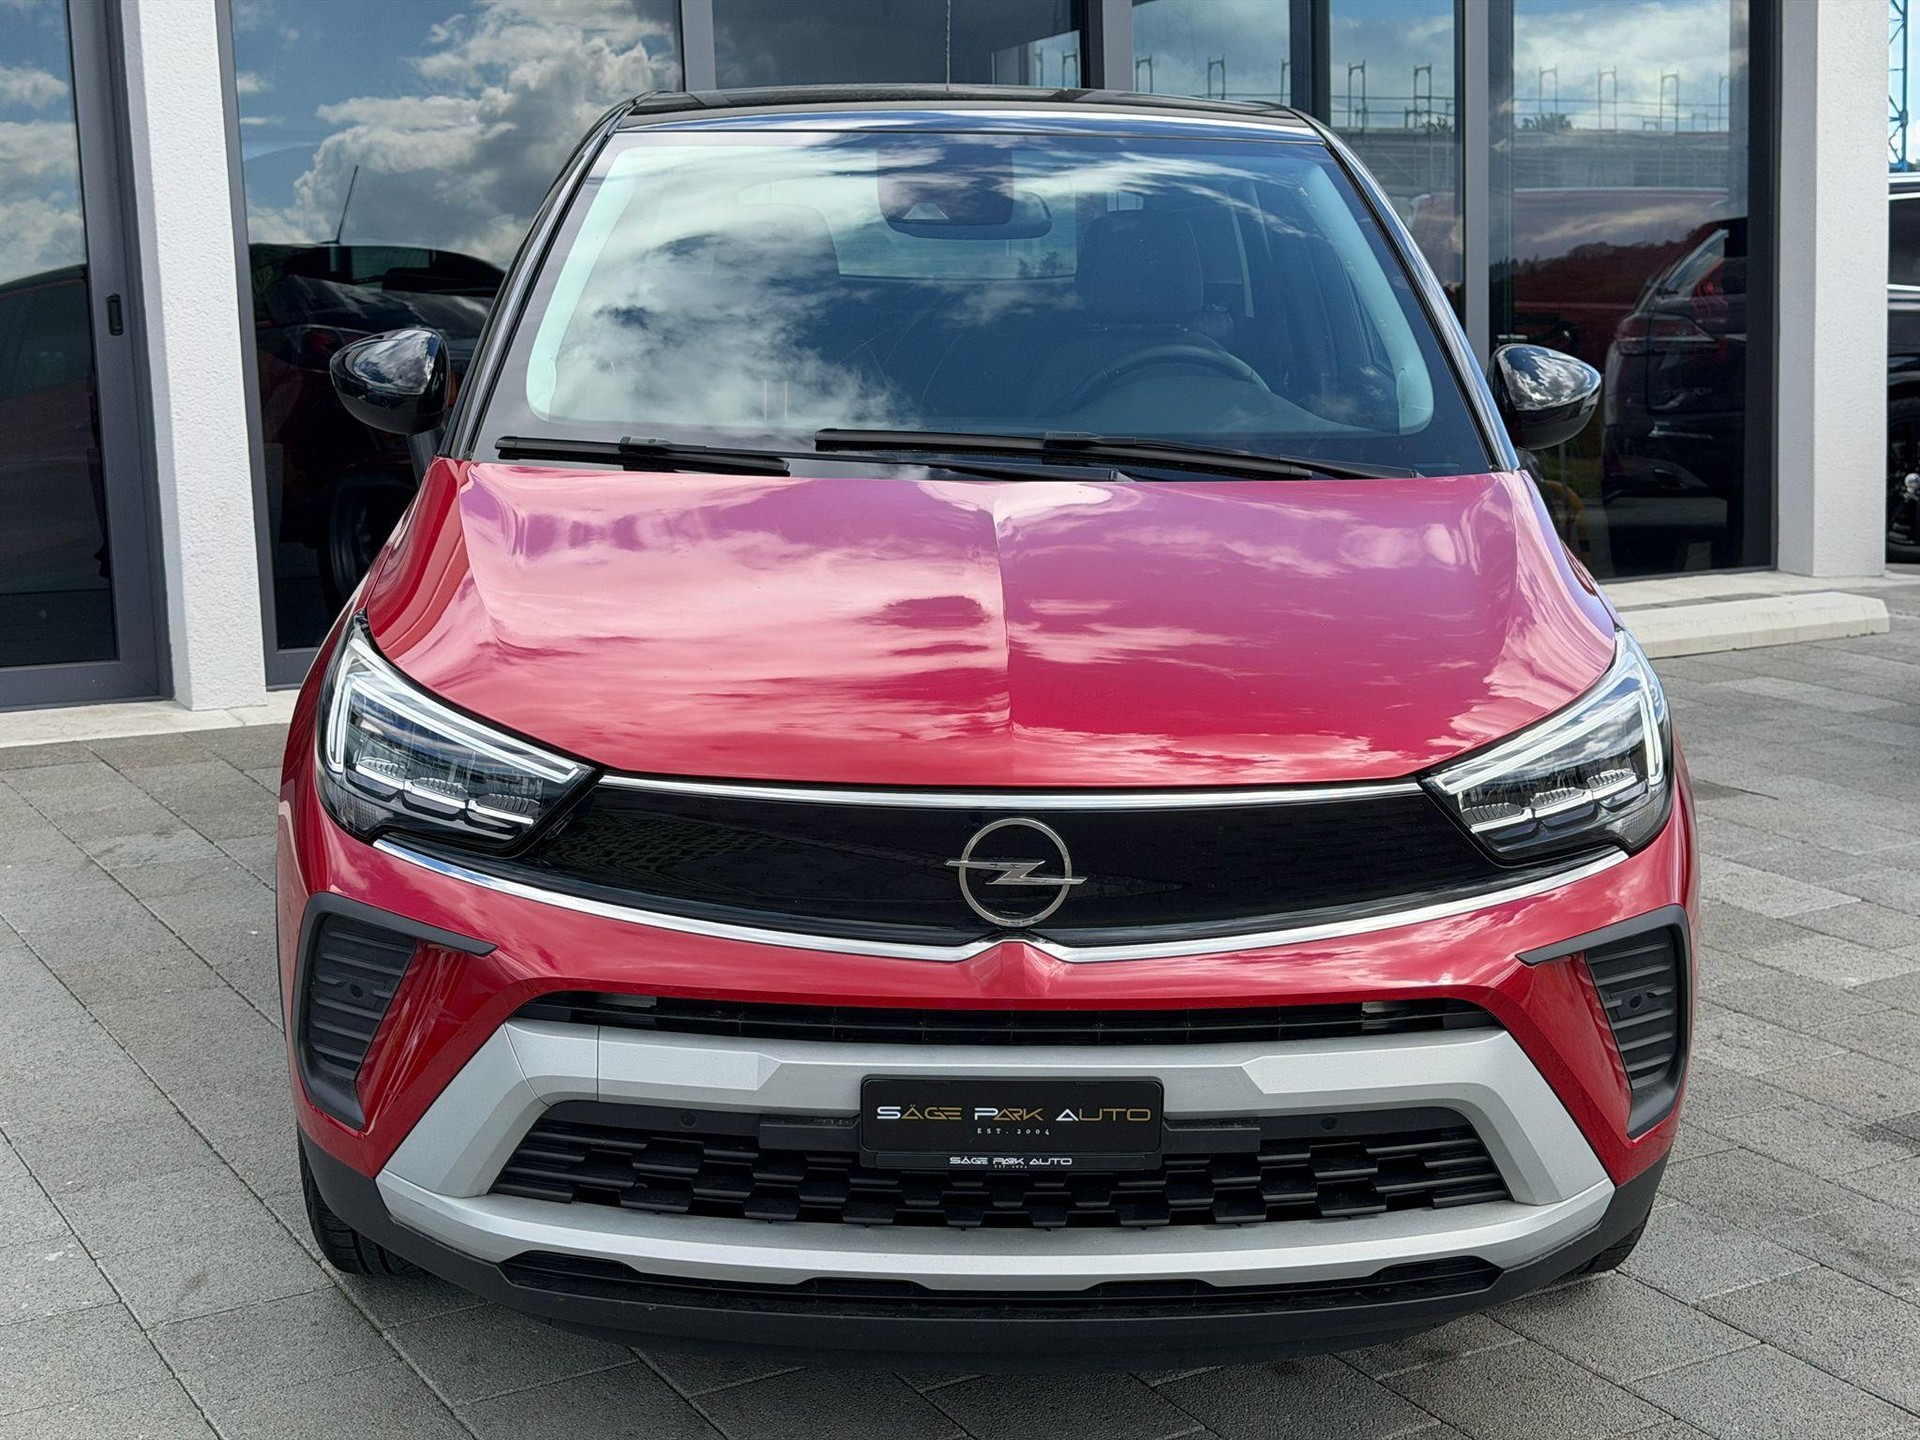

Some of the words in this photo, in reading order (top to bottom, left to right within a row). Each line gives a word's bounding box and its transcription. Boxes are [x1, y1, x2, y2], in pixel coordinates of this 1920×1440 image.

[876, 1105, 962, 1120] SÄGE
[974, 1107, 1044, 1121] PARK
[1055, 1108, 1151, 1122] AUTO
[977, 1127, 1010, 1135] EST.
[1017, 1127, 1050, 1136] 2004
[993, 1157, 1024, 1165] PARK
[1029, 1157, 1073, 1165] AUTO
